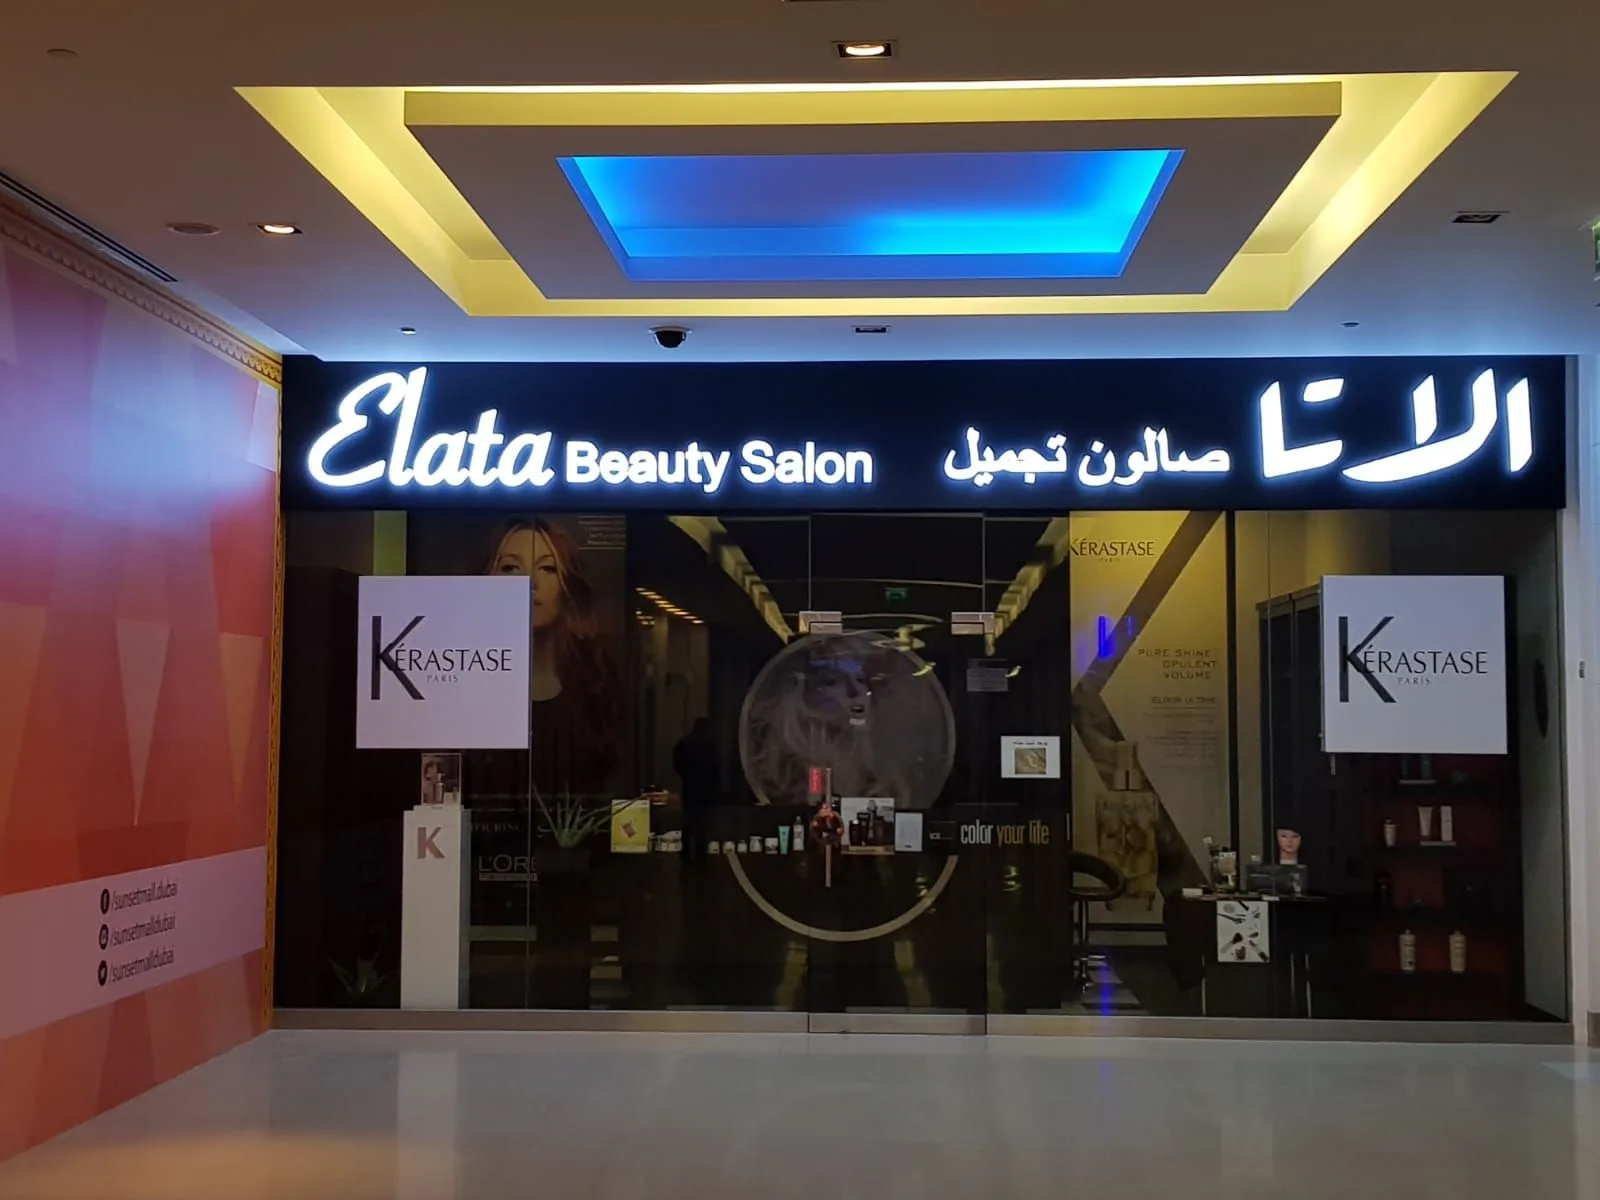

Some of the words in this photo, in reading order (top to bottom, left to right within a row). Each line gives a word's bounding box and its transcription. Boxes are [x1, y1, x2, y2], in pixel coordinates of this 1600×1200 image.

[307, 366, 555, 487] Elata
[565, 440, 730, 493] Beauty
[739, 439, 873, 485] Salon
[943, 427, 1067, 487] تجميل
[1078, 427, 1231, 487] صالون
[371, 615, 513, 701] KÉRASTASE
[1138, 648, 1169, 657] PURE
[1174, 648, 1212, 658] SHINE
[1162, 659, 1217, 669] OPULENT
[1338, 616, 1488, 703] KÉRASTASE
[426, 674, 459, 684] PARIS
[1163, 671, 1212, 680] VOLUME
[1397, 676, 1432, 686] PARIS
[416, 826, 446, 860] K
[960, 818, 994, 845] color
[996, 824, 1025, 848] your
[1028, 819, 1050, 845] life
